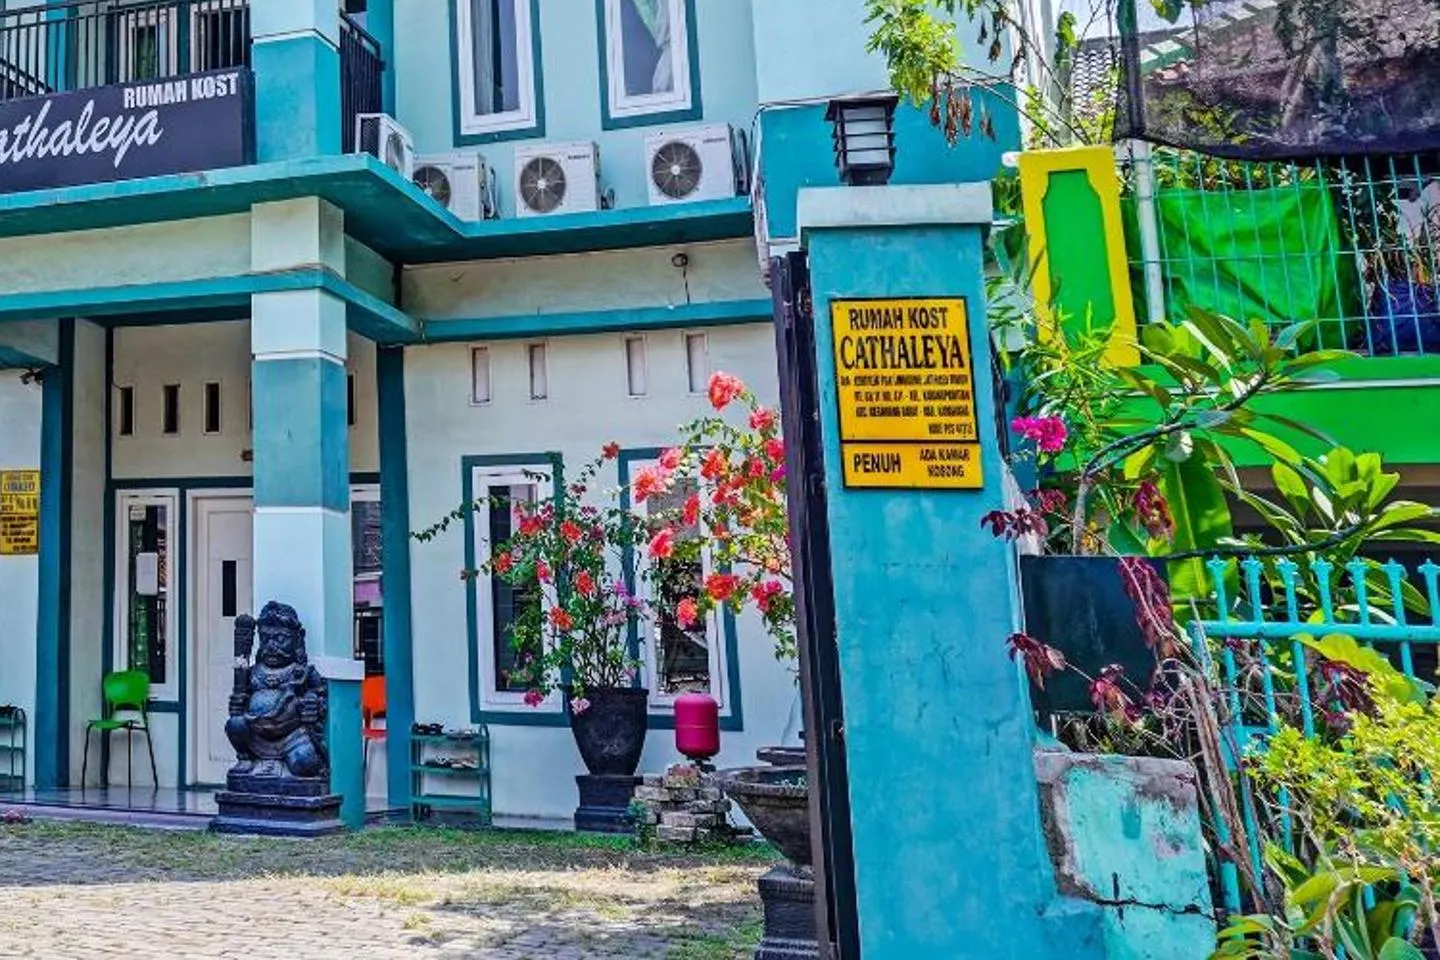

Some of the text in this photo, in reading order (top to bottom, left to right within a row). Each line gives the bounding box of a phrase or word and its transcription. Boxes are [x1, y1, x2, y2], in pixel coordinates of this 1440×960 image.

[124, 72, 239, 109] RUMAH KOST
[850, 307, 949, 330] RUMAH KOST
[840, 336, 964, 369] CATHALEYA
[853, 452, 902, 473] PENUH
[919, 448, 970, 461] ADA KAMAR
